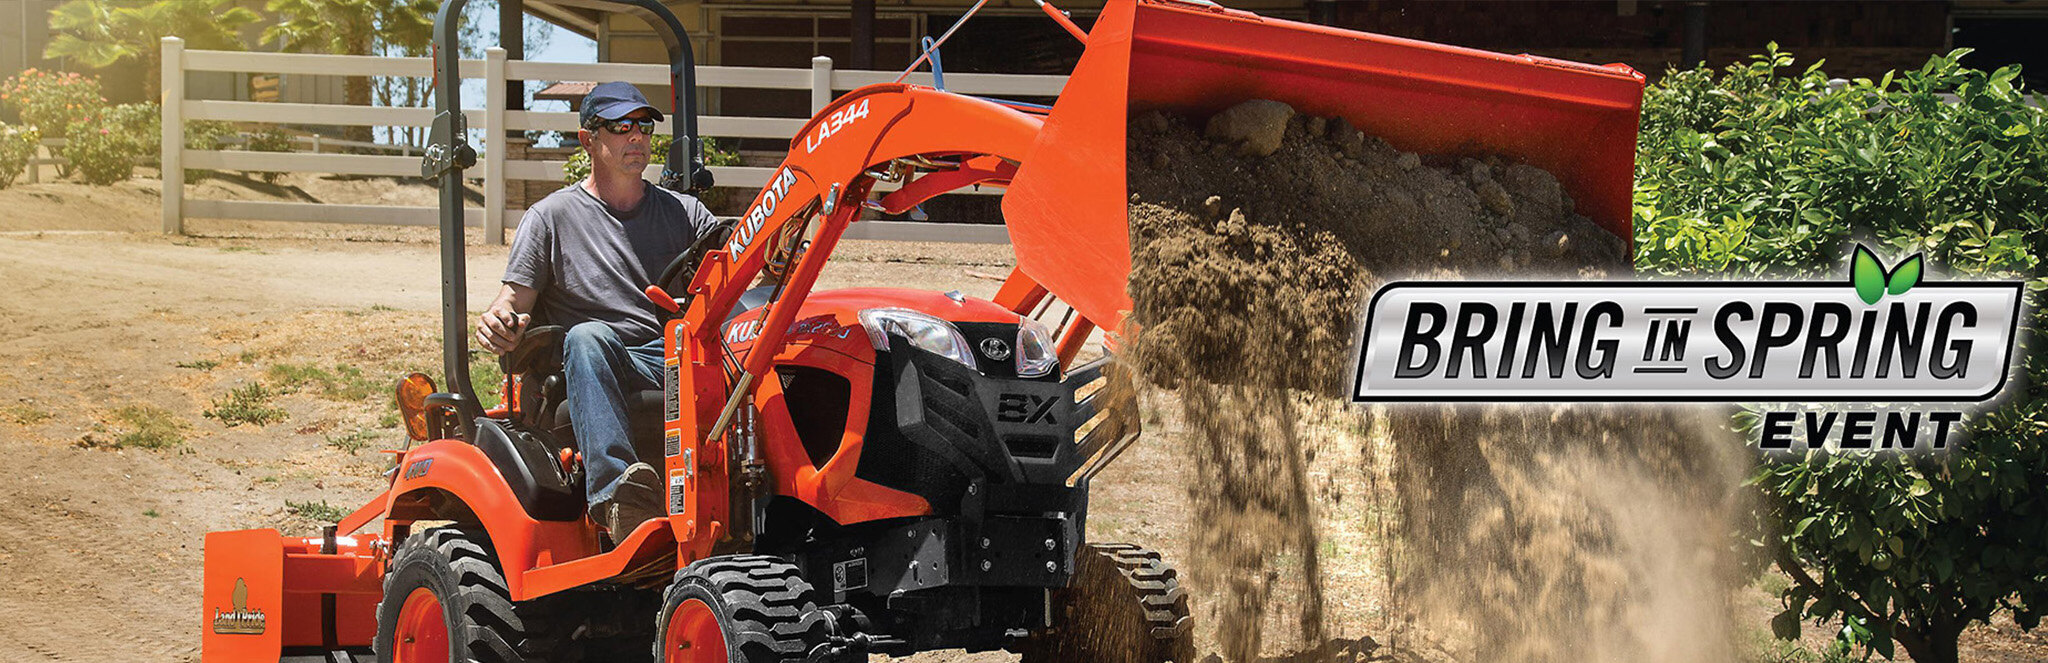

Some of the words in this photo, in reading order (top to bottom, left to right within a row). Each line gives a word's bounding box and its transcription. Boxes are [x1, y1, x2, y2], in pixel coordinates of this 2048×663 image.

[806, 98, 869, 154] LA344
[728, 165, 798, 263] KUBOTA
[998, 394, 1060, 425] BX
